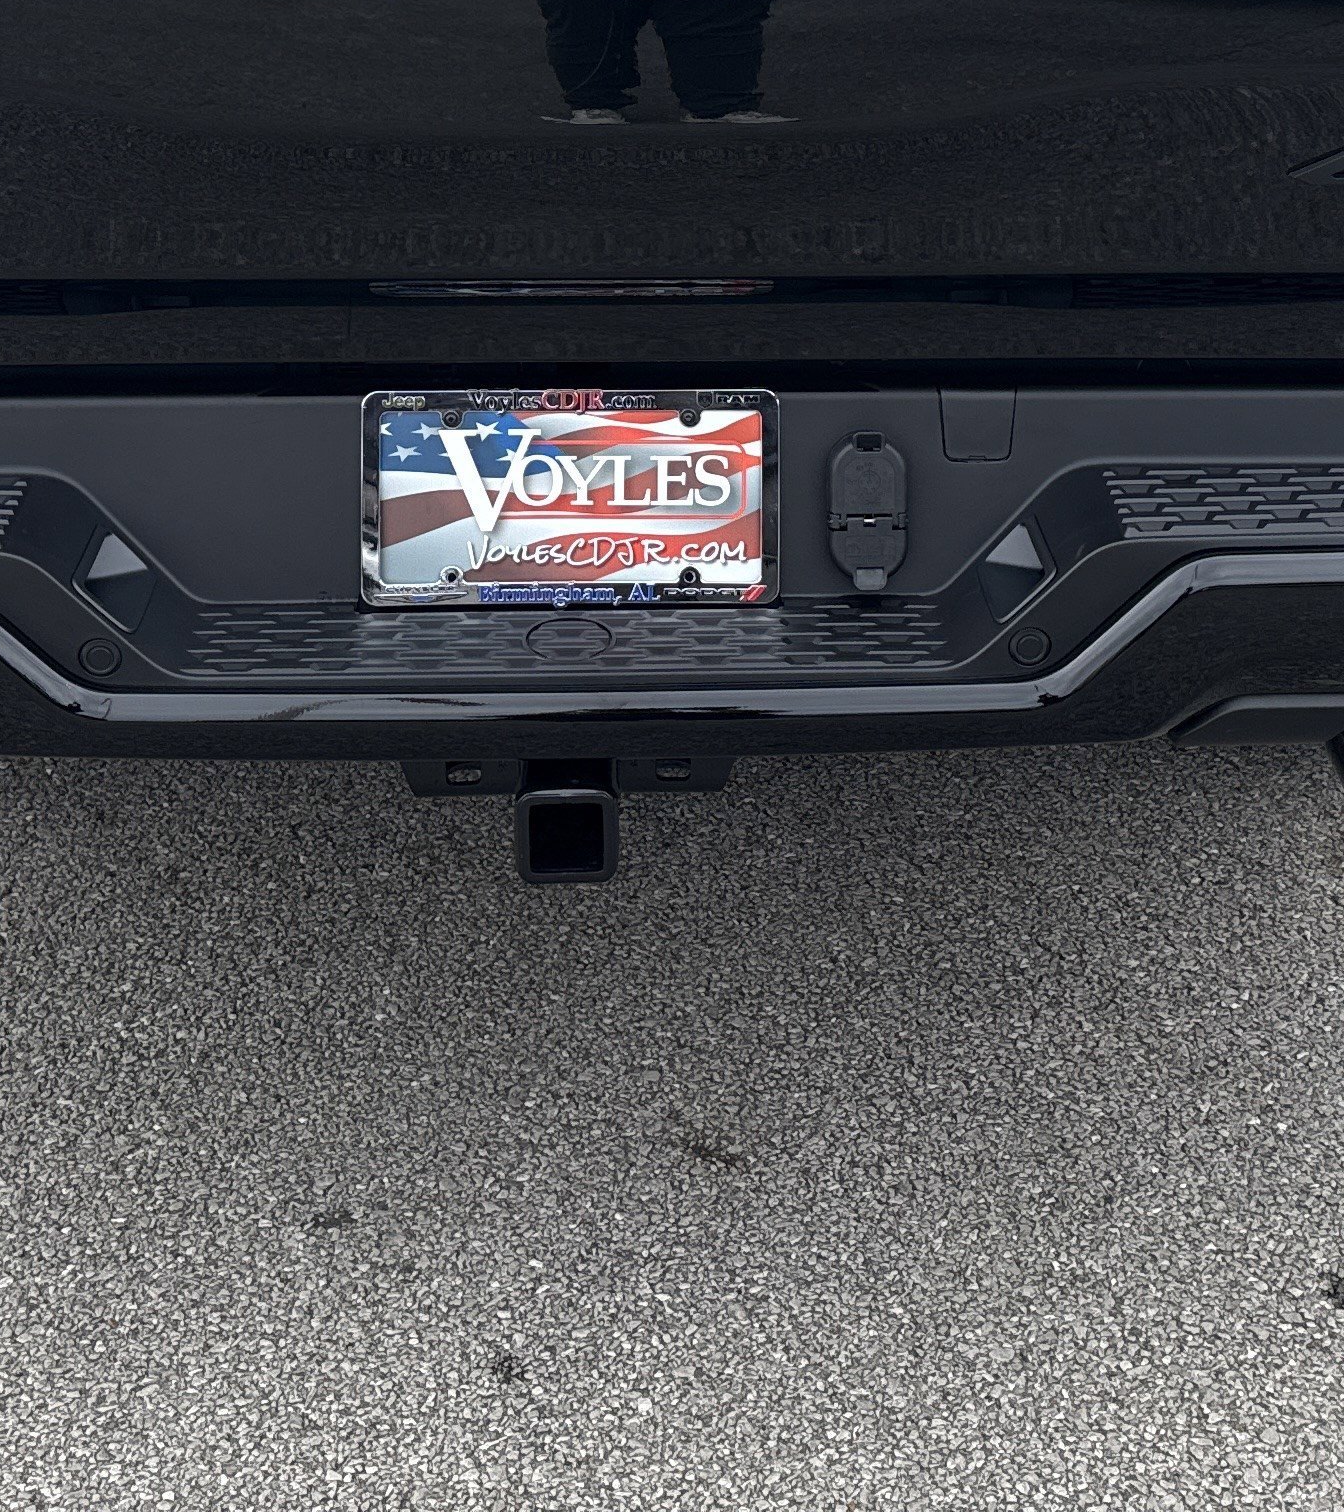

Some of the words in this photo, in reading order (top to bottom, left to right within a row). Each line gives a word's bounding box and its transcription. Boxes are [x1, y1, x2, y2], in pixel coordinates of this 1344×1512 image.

[382, 392, 426, 411] Jeep
[467, 389, 657, 415] VoylesCDJR.com
[716, 394, 761, 405] RAM
[438, 428, 732, 533] VOYLES
[477, 581, 622, 607] Birmingham,
[628, 582, 661, 602] AL
